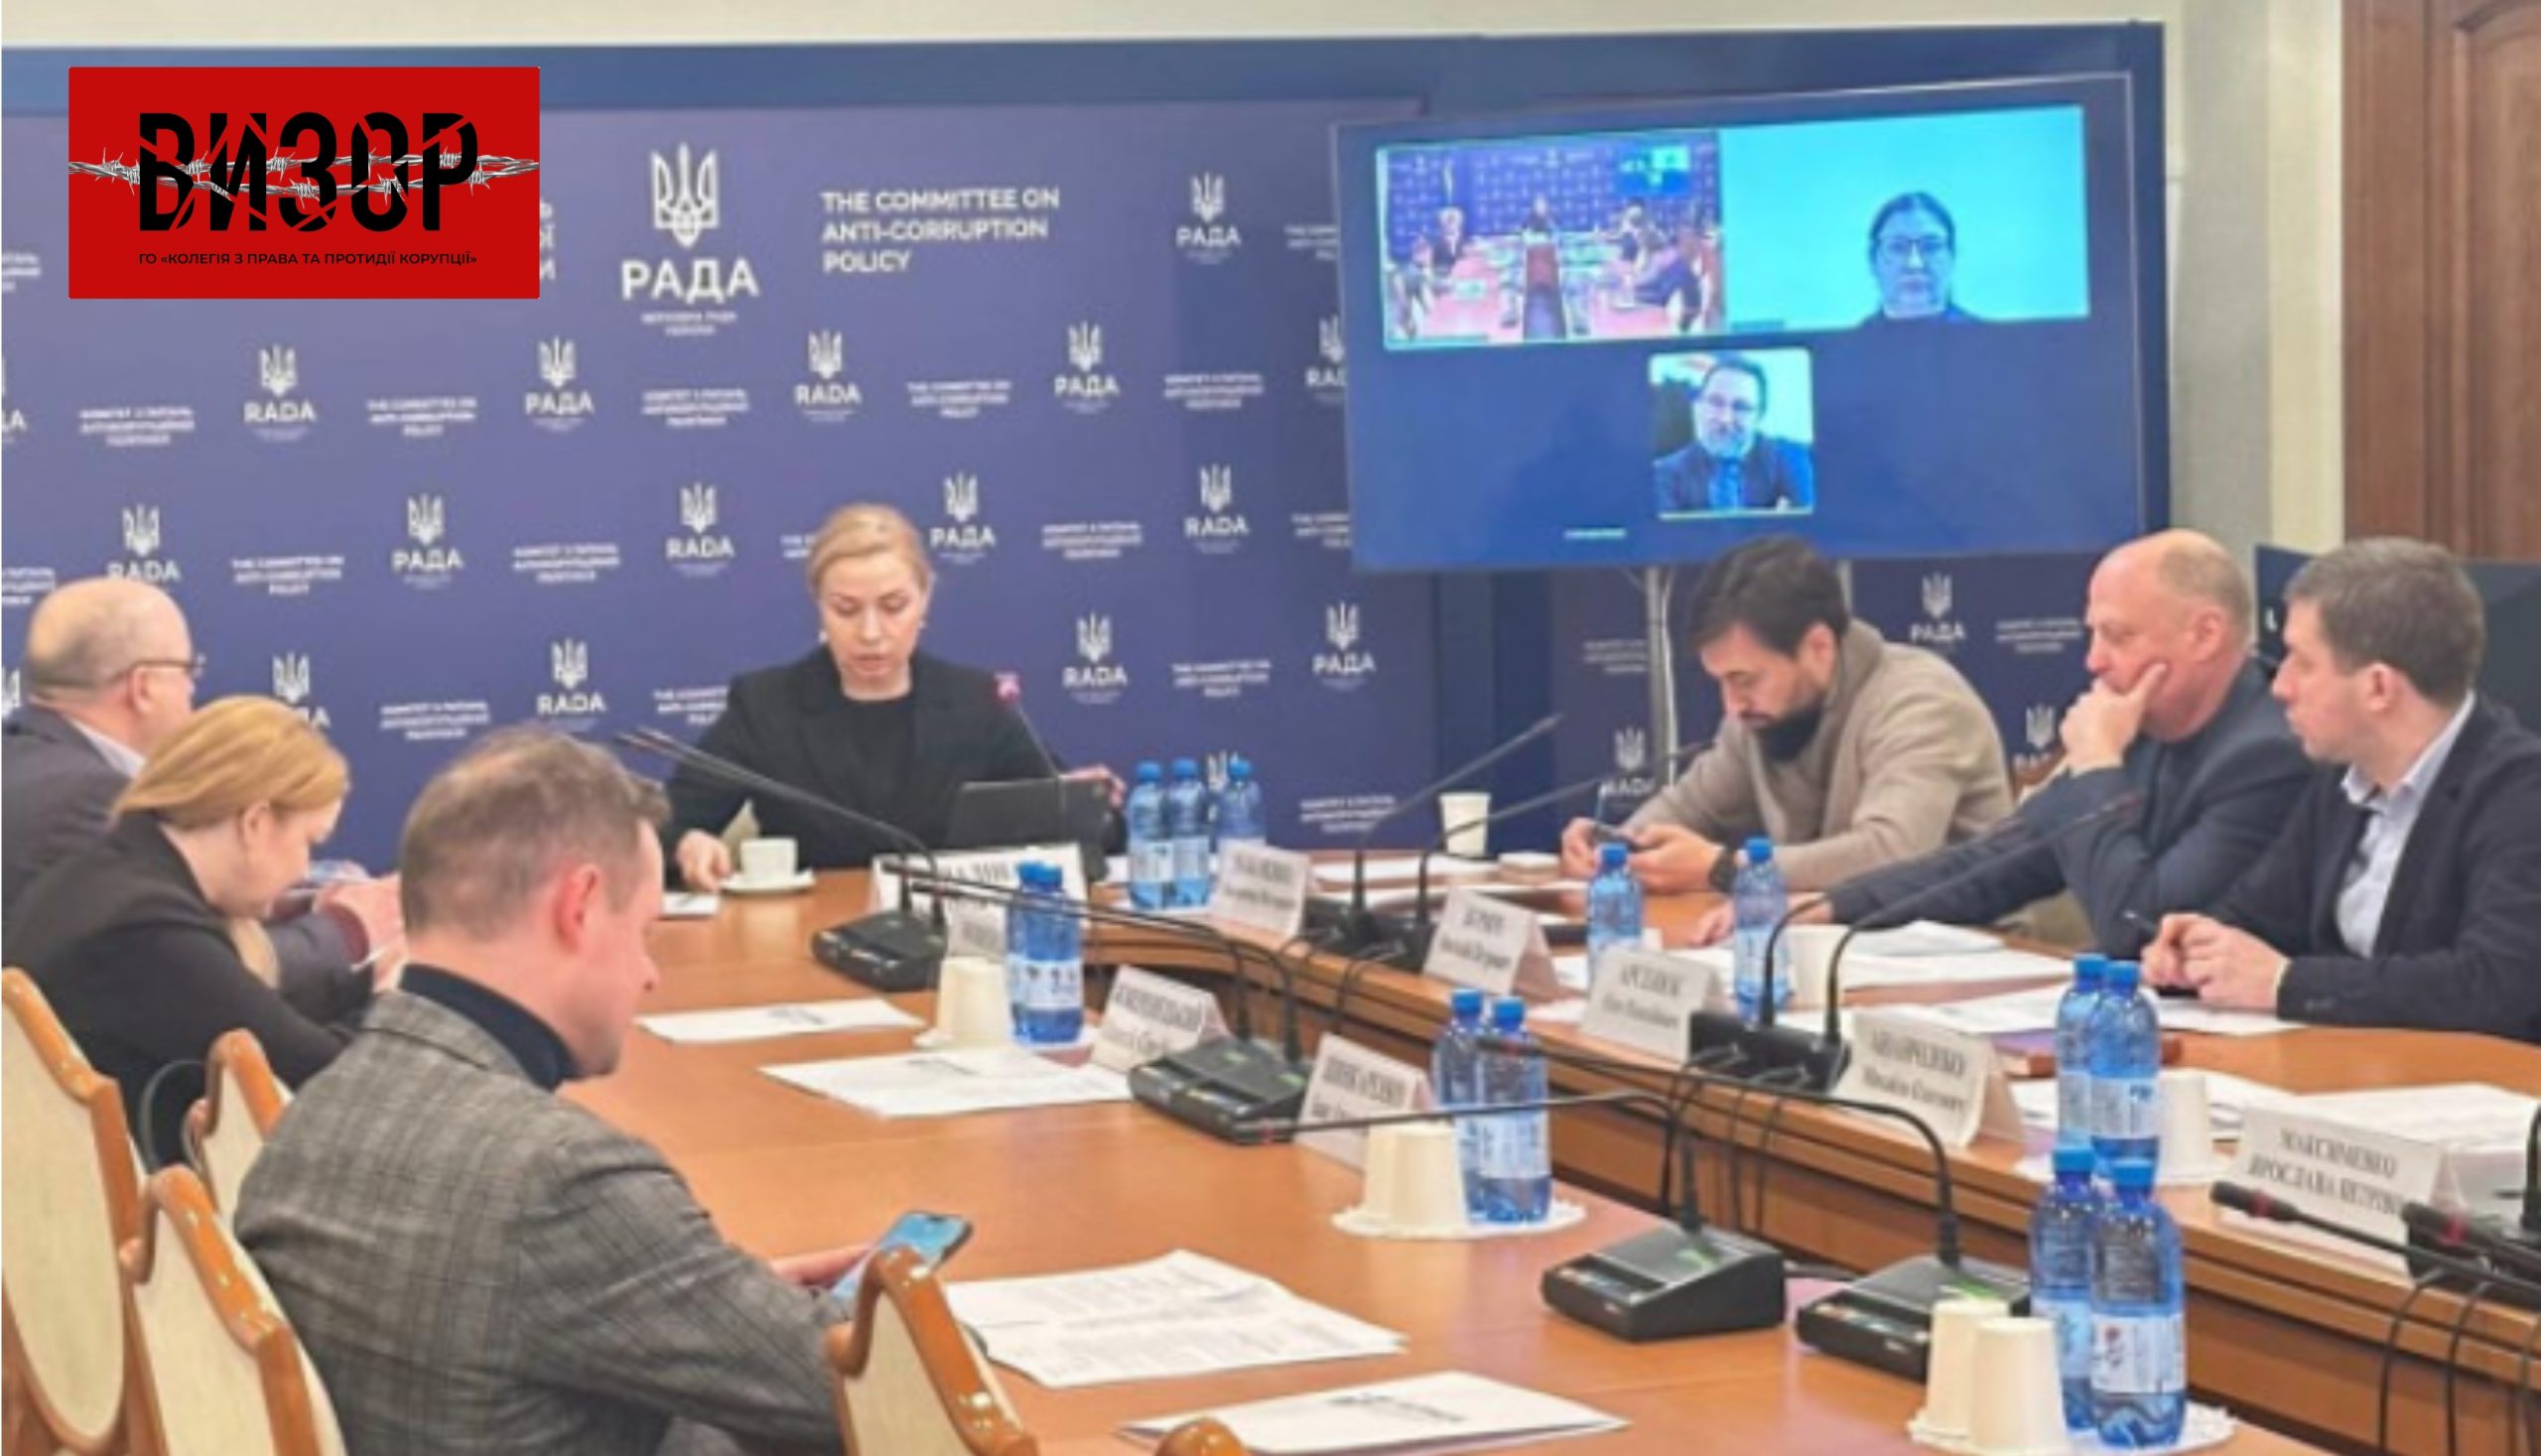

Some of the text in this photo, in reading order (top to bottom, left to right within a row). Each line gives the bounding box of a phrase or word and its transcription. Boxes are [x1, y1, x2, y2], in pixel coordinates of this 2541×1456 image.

[823, 186, 1060, 212] THE COMMITTEE ON
[822, 217, 1050, 243] ANTI-CORRUPTION
[823, 249, 912, 274] POLICY
[621, 257, 760, 304] РАДА
